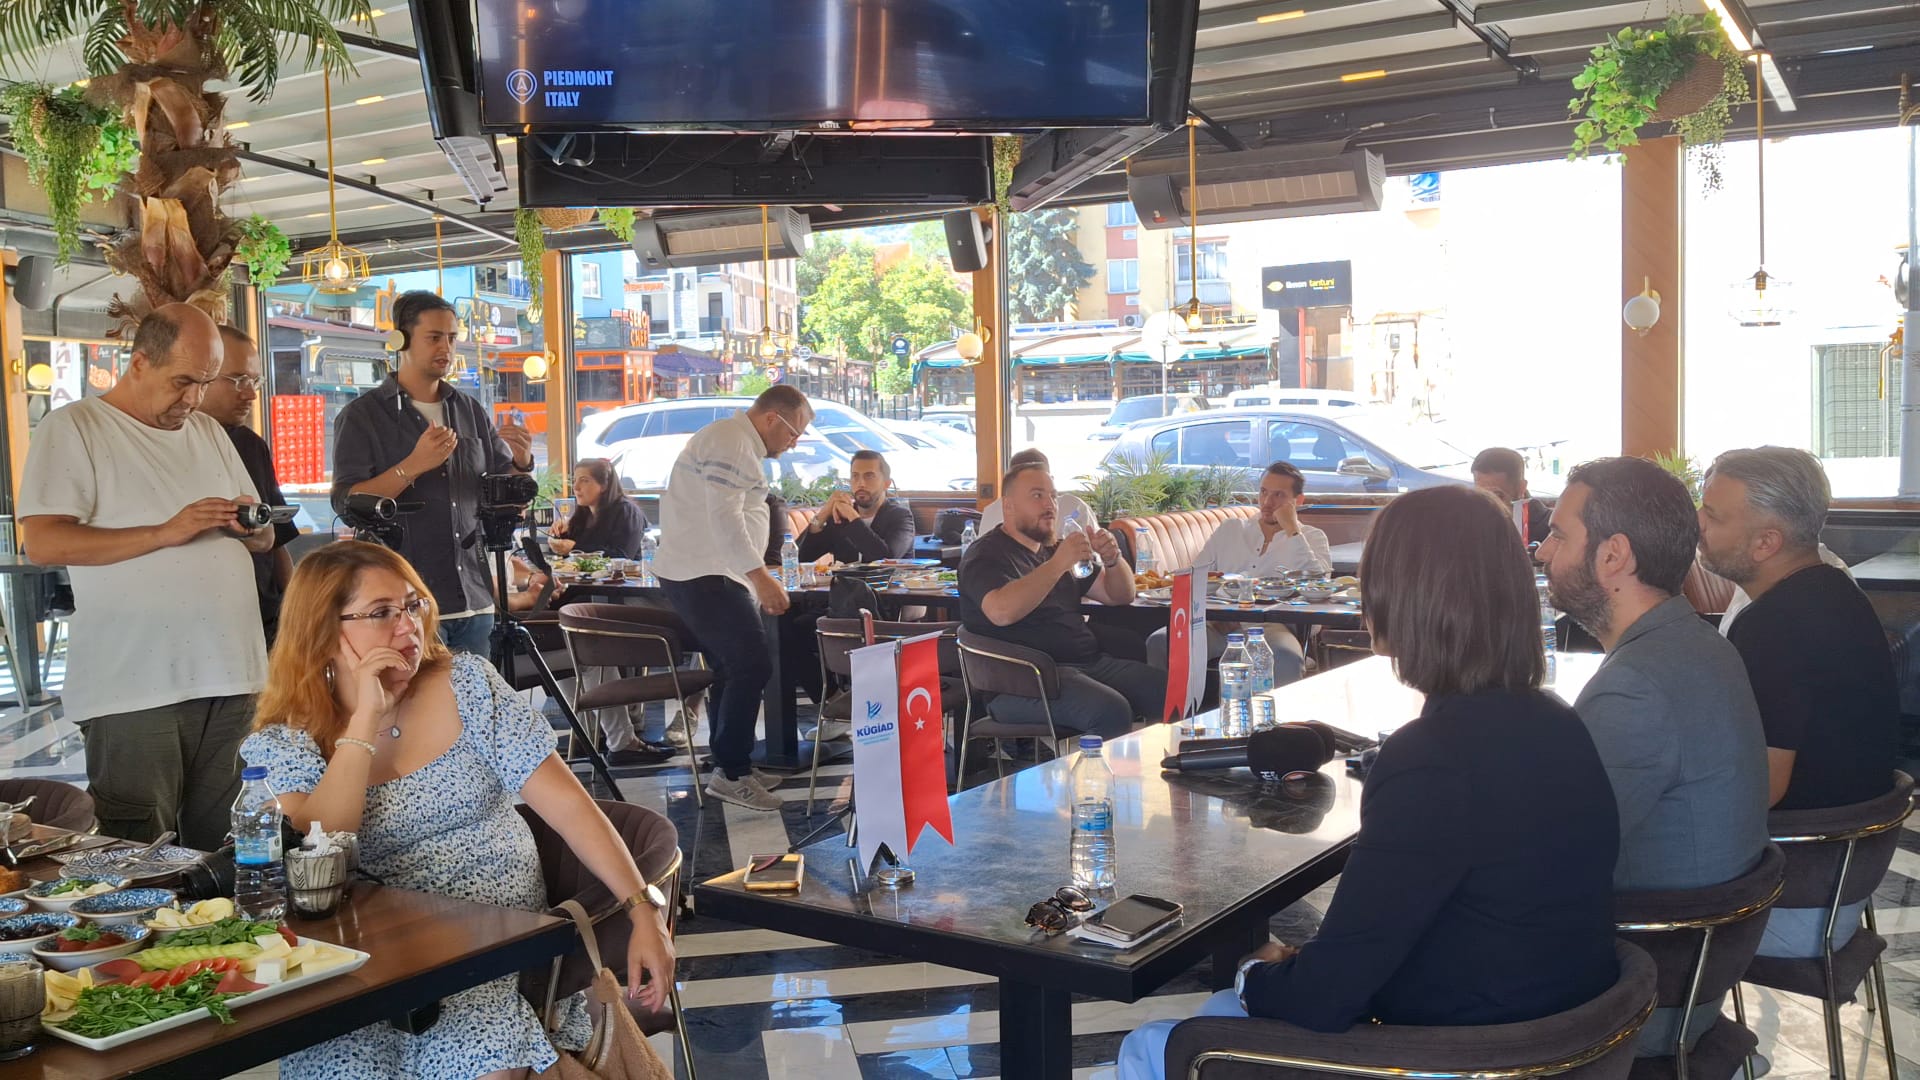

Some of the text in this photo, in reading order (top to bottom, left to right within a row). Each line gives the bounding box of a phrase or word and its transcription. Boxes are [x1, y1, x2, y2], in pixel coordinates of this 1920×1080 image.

[544, 70, 613, 86] PIEDMONT
[545, 92, 580, 107] ITALY
[857, 722, 894, 737] KÜGİAD
